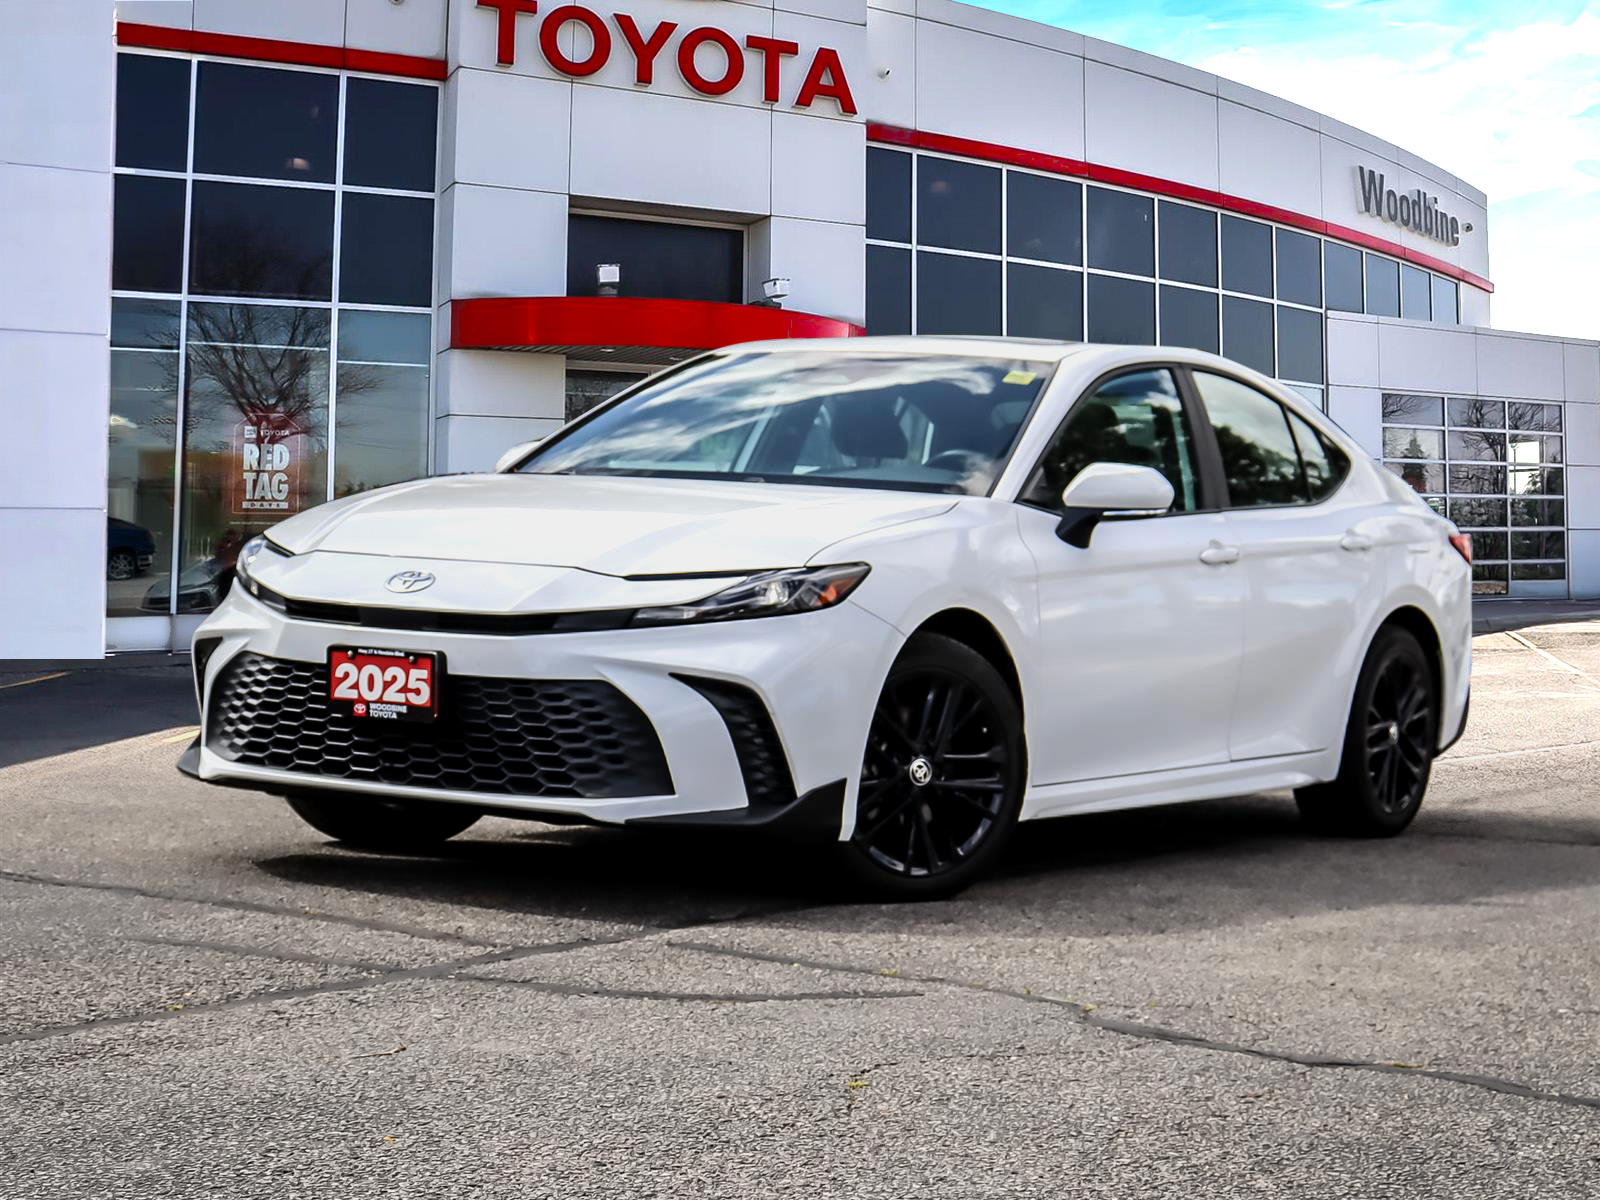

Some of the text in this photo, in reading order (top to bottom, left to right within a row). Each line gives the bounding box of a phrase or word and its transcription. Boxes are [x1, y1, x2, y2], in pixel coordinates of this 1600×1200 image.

[476, 0, 858, 117] TOYOTA
[1354, 164, 1460, 247] Woodbine
[260, 429, 290, 437] TOYOTA
[243, 443, 289, 471] RED
[243, 472, 289, 500] TAG
[334, 662, 431, 705] 2025
[369, 702, 407, 713] WOODBINE
[369, 709, 398, 719] TOYOTA
